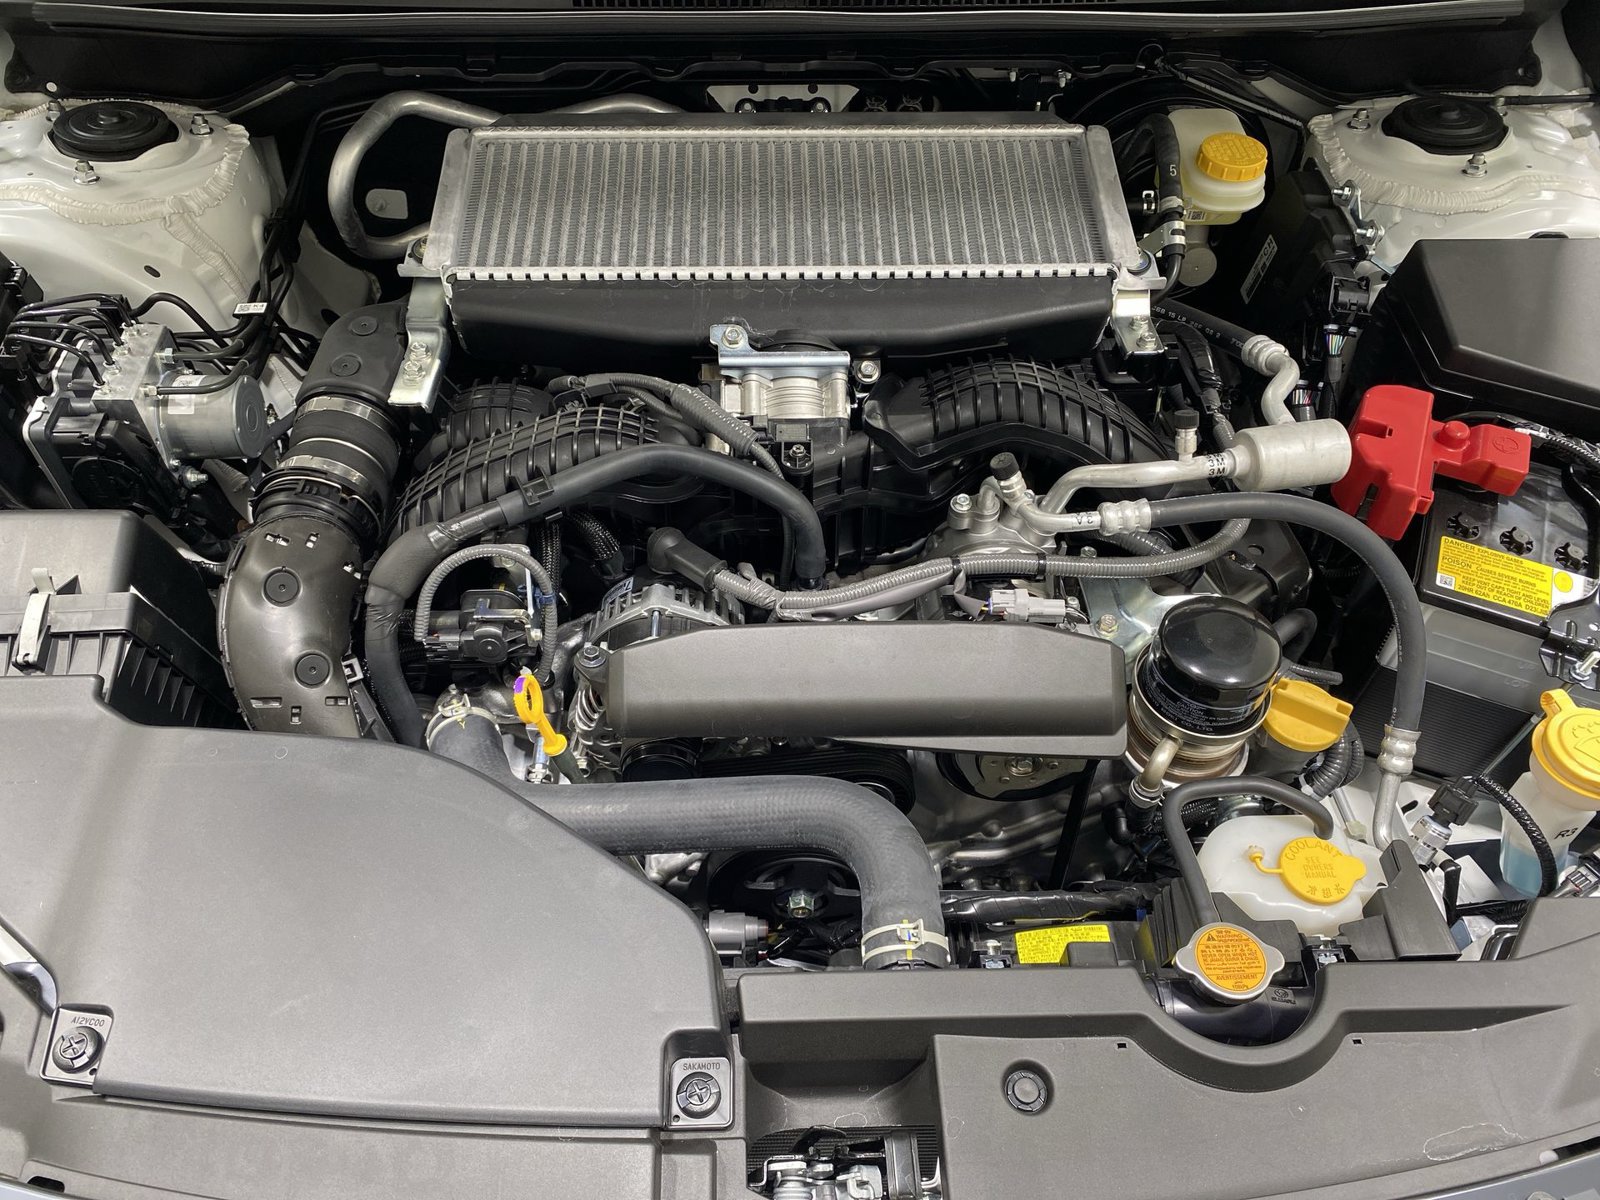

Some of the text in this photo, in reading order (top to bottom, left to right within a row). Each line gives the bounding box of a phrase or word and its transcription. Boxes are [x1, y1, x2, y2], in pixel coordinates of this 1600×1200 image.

[1170, 164, 1177, 176] 5
[1208, 457, 1226, 468] 3M
[1208, 466, 1226, 476] 3M
[1444, 537, 1475, 551] DANGER
[1442, 555, 1471, 569] POISON
[1492, 594, 1506, 603] CCA
[1554, 827, 1578, 840] R3
[1284, 838, 1344, 860] COOLANT
[682, 1062, 720, 1070] SAKAMOTO
